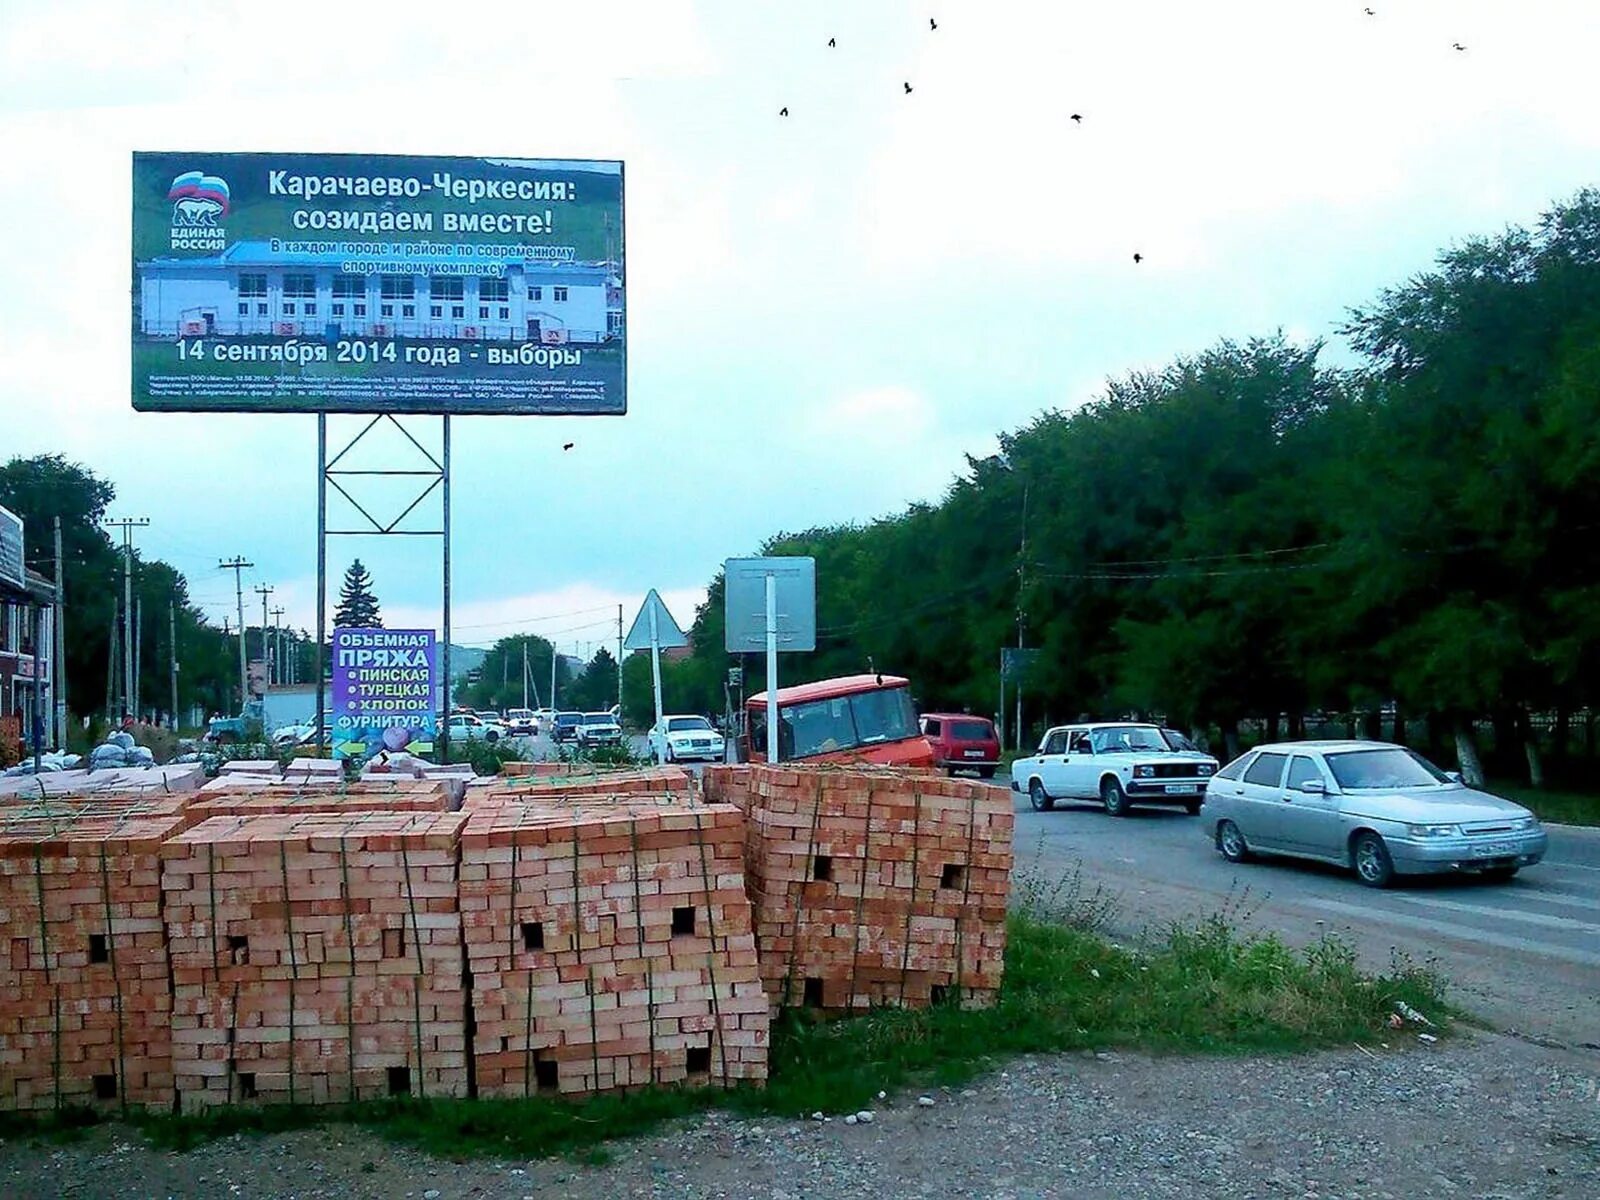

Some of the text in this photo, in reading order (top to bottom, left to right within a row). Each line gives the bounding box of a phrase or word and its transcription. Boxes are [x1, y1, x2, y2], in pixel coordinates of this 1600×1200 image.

[269, 170, 576, 202] Карачаево-Черкесия:
[293, 210, 552, 233] созидаем вместе!
[171, 228, 225, 238] ЕДИНАЯ
[171, 239, 225, 249] РОССИЯ
[271, 239, 575, 262] В каждом городе и районе по современному
[342, 261, 507, 278] спортивному комплексу
[176, 339, 205, 360] 14
[213, 339, 328, 365] сентября
[336, 341, 397, 362] 2014
[405, 347, 461, 366] года
[487, 343, 582, 369] выборы
[340, 634, 429, 647] ОБЪЕМНАЯ
[339, 649, 429, 667] ПРЯЖА
[359, 669, 430, 681] ПИНСКАЯ
[359, 684, 430, 698] ТУРЕЦКАЯ
[360, 700, 429, 710] ХЛОПОК
[338, 715, 431, 729] ФУРНИТУРА
